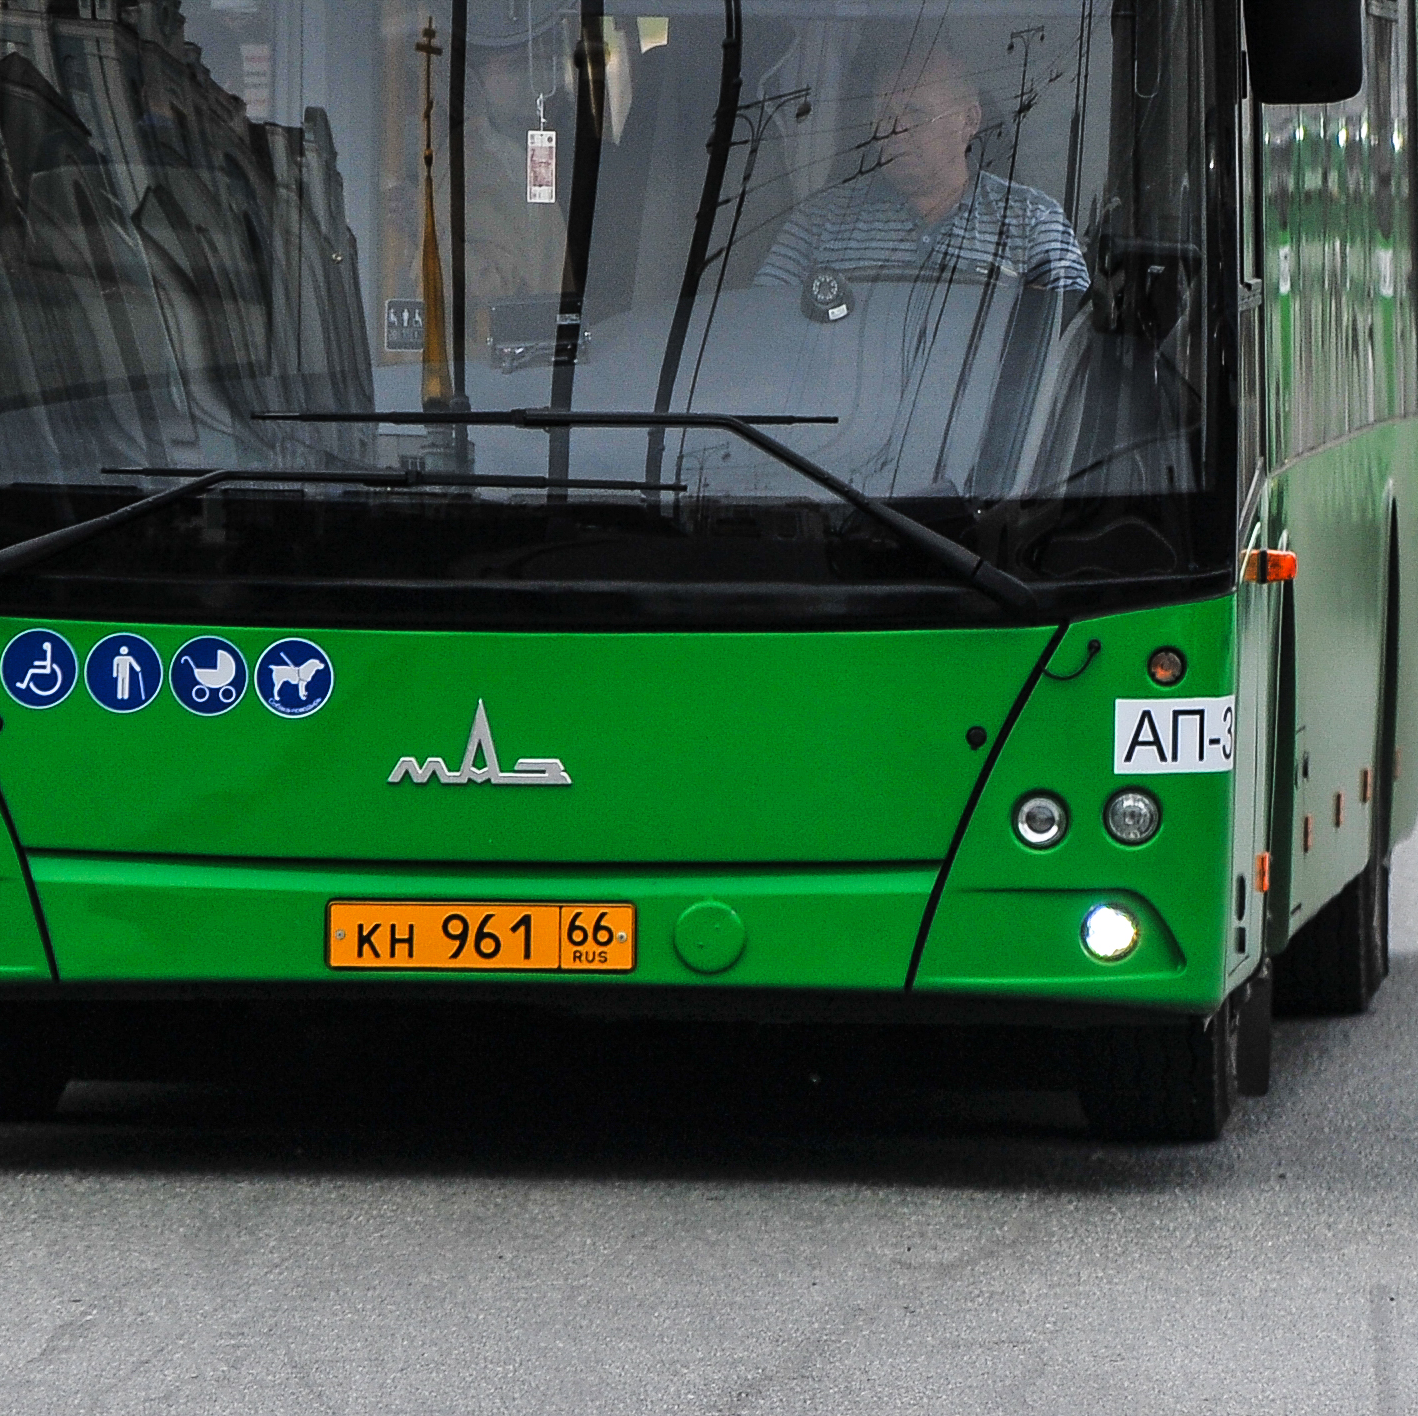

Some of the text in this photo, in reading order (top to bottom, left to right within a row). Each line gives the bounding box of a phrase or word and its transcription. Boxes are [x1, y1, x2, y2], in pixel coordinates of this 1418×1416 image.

[357, 911, 614, 960] КН 961 66
[572, 950, 608, 964] RUS
